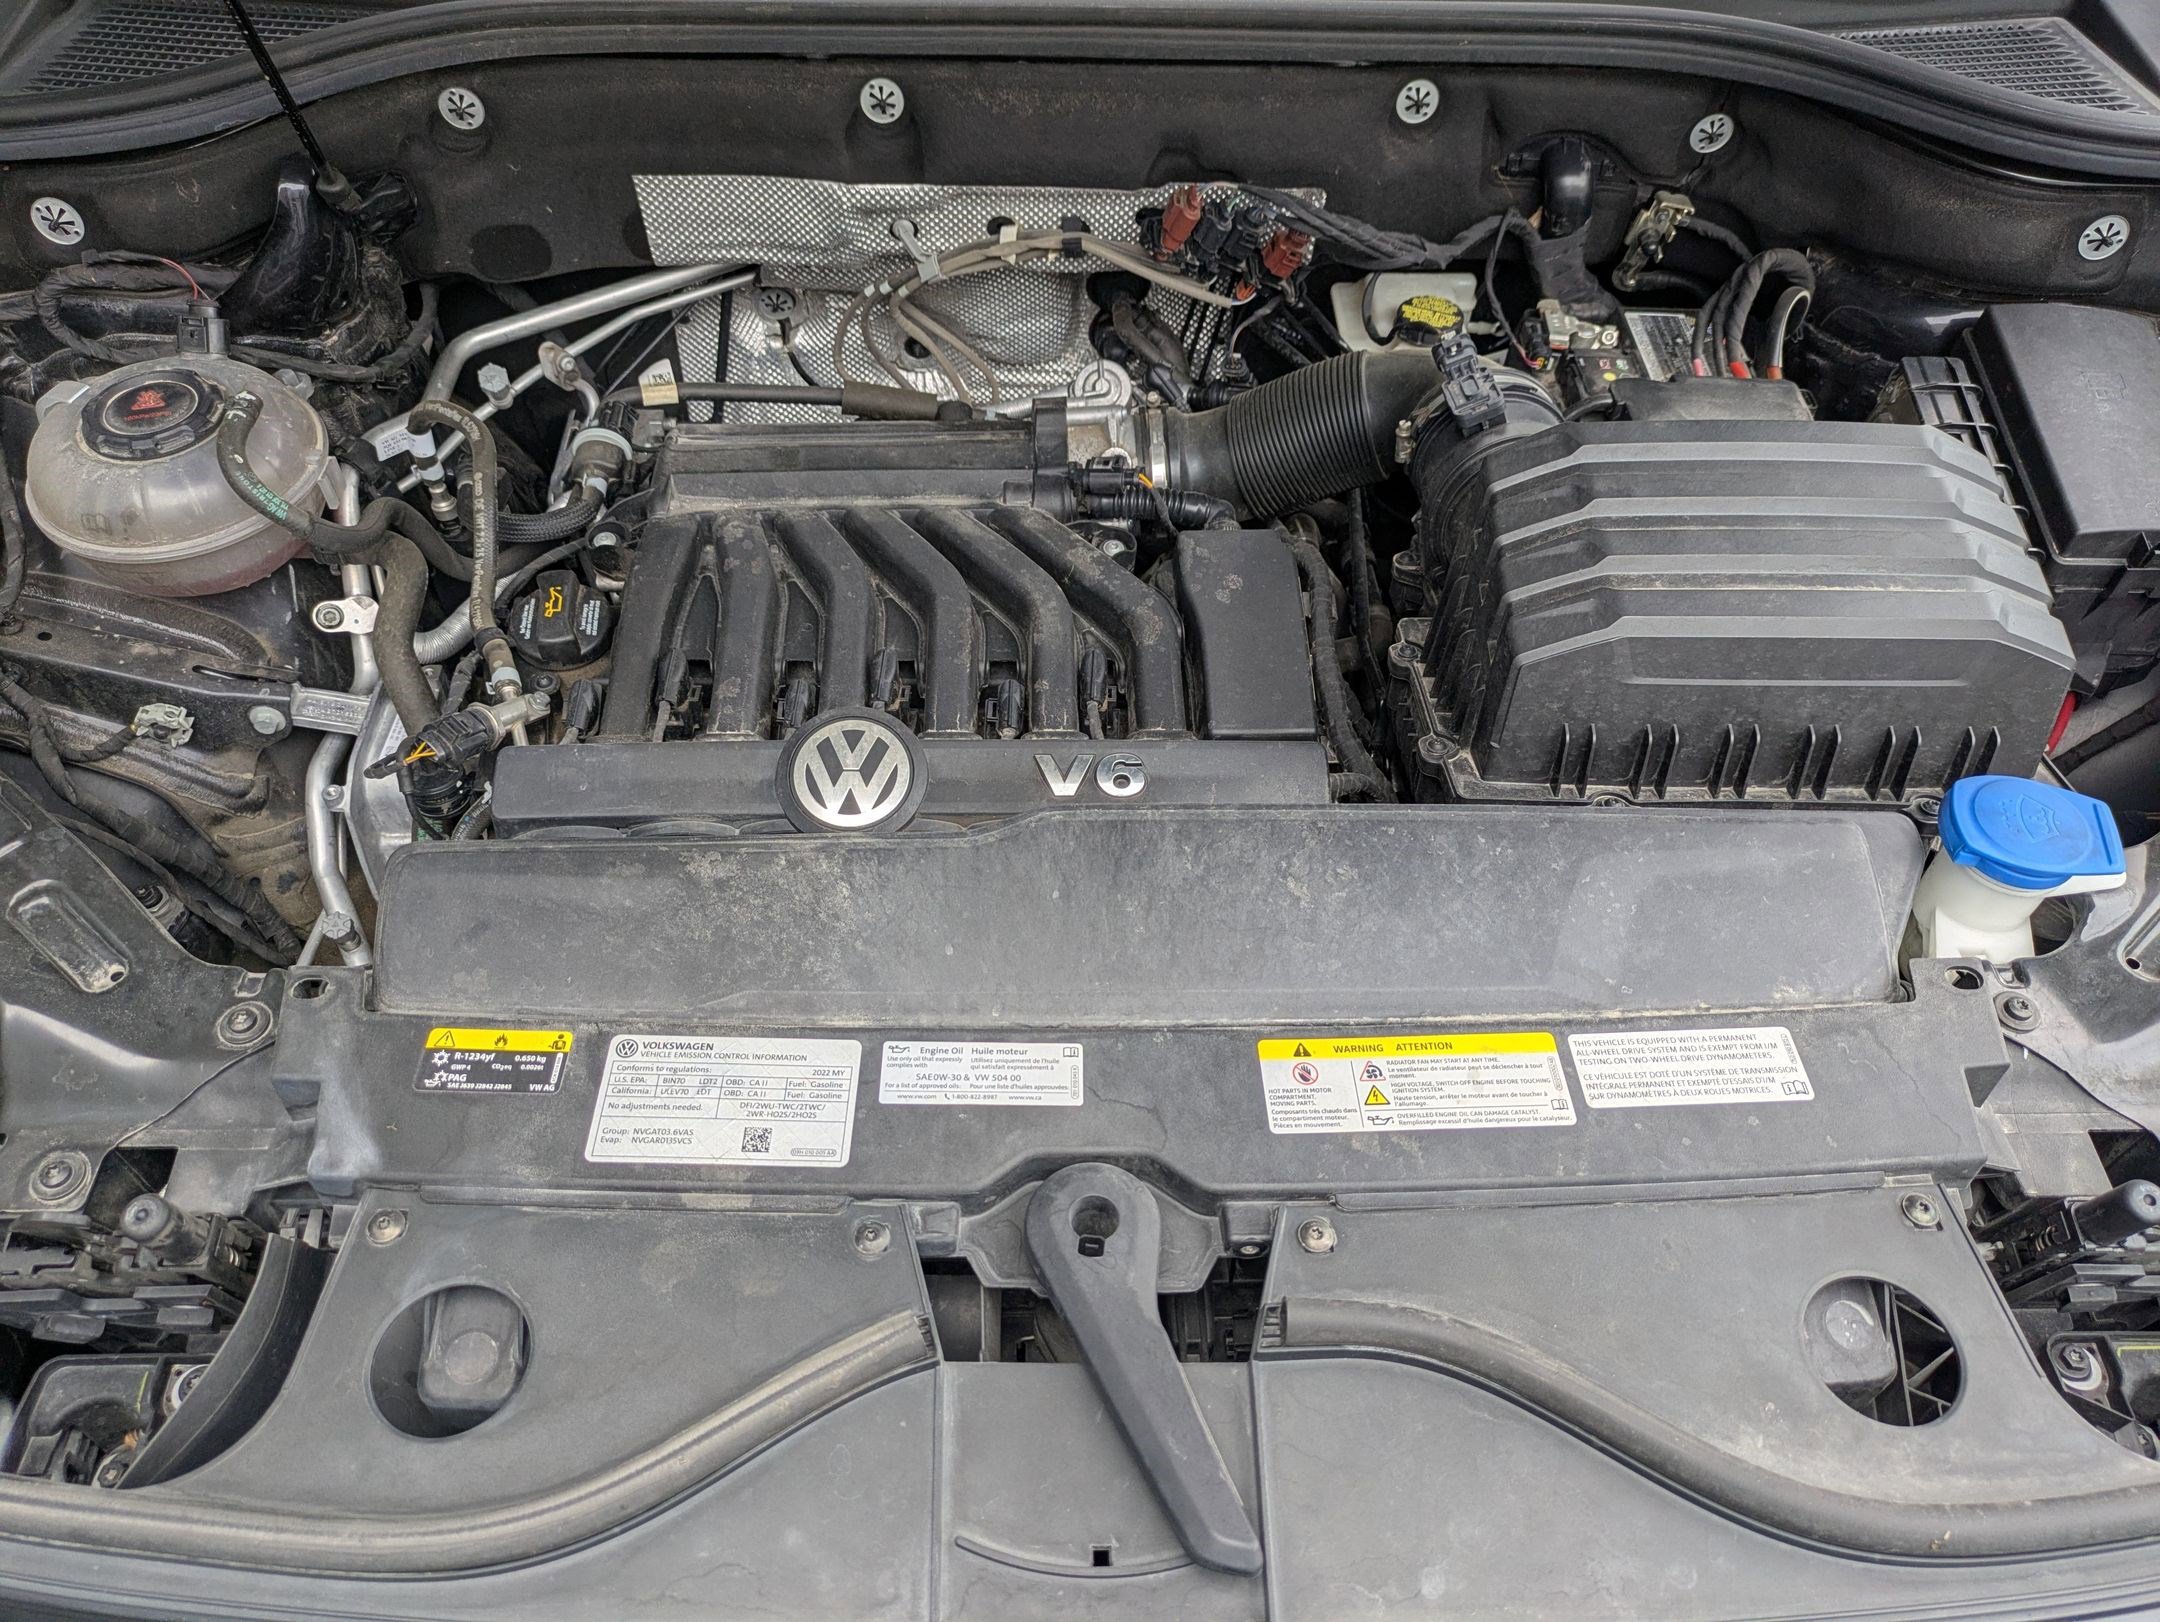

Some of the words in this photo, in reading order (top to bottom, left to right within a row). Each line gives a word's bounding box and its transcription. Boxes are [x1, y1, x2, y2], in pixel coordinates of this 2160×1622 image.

[794, 719, 910, 827] VW
[1033, 752, 1148, 799] V6
[1593, 1038, 1627, 1046] VEHICLE
[1636, 1036, 1676, 1046] EQUIPPED
[1678, 1035, 1699, 1043] WITH
[1709, 1033, 1757, 1042] PERMANENT
[642, 1041, 714, 1050] VOLKSWAGEN
[1333, 1044, 1384, 1053] WARNING
[1396, 1042, 1453, 1051] ATTENTION
[1576, 1047, 1621, 1057] ALL-WHEEL
[1622, 1046, 1646, 1055] DRIVE
[1647, 1045, 1678, 1054] SYSTEM
[1679, 1044, 1697, 1052] AND
[1708, 1043, 1738, 1051] EXEMPT
[674, 1051, 711, 1059] EMISSION
[713, 1052, 750, 1060] CONTROL
[920, 1046, 949, 1056] Engine
[971, 1047, 994, 1055] Huile
[454, 1053, 496, 1064] R-1234yf
[537, 1055, 546, 1063] kg
[1579, 1058, 1612, 1066] TESTING
[1614, 1056, 1627, 1065] ON
[1629, 1055, 1680, 1064] TWO-WHEEL
[1706, 1052, 1775, 1061] DYNAMOMETERS.
[617, 1064, 654, 1072] Conforms
[666, 1065, 712, 1074] regulations:
[1583, 1073, 1593, 1081] CE
[1594, 1071, 1633, 1080] VÉHICULE
[1649, 1070, 1671, 1078] DOTÉ
[1694, 1066, 1728, 1076] SYSTÈME
[1728, 1067, 1739, 1075] DE
[1739, 1066, 1798, 1075] TRANSMISSION
[916, 1073, 962, 1081] SAE0W-30
[810, 1081, 843, 1089] Gasoline
[1586, 1080, 1629, 1090] INTÉGRALE
[1629, 1080, 1676, 1088] PERMANENT
[1687, 1078, 1721, 1087] EXEMPTÉ
[1589, 1092, 1606, 1100] SUR
[1607, 1089, 1673, 1099] DYNAMOMÈTRES
[1673, 1089, 1680, 1097] À
[1705, 1087, 1731, 1096] ROUES
[1732, 1086, 1773, 1094] MOTRICES.
[621, 1102, 670, 1111] adjustments
[746, 1111, 817, 1119] 2WR-HO2S/2HO2S
[602, 1127, 629, 1136] Group:
[600, 1136, 622, 1144] Evap:
